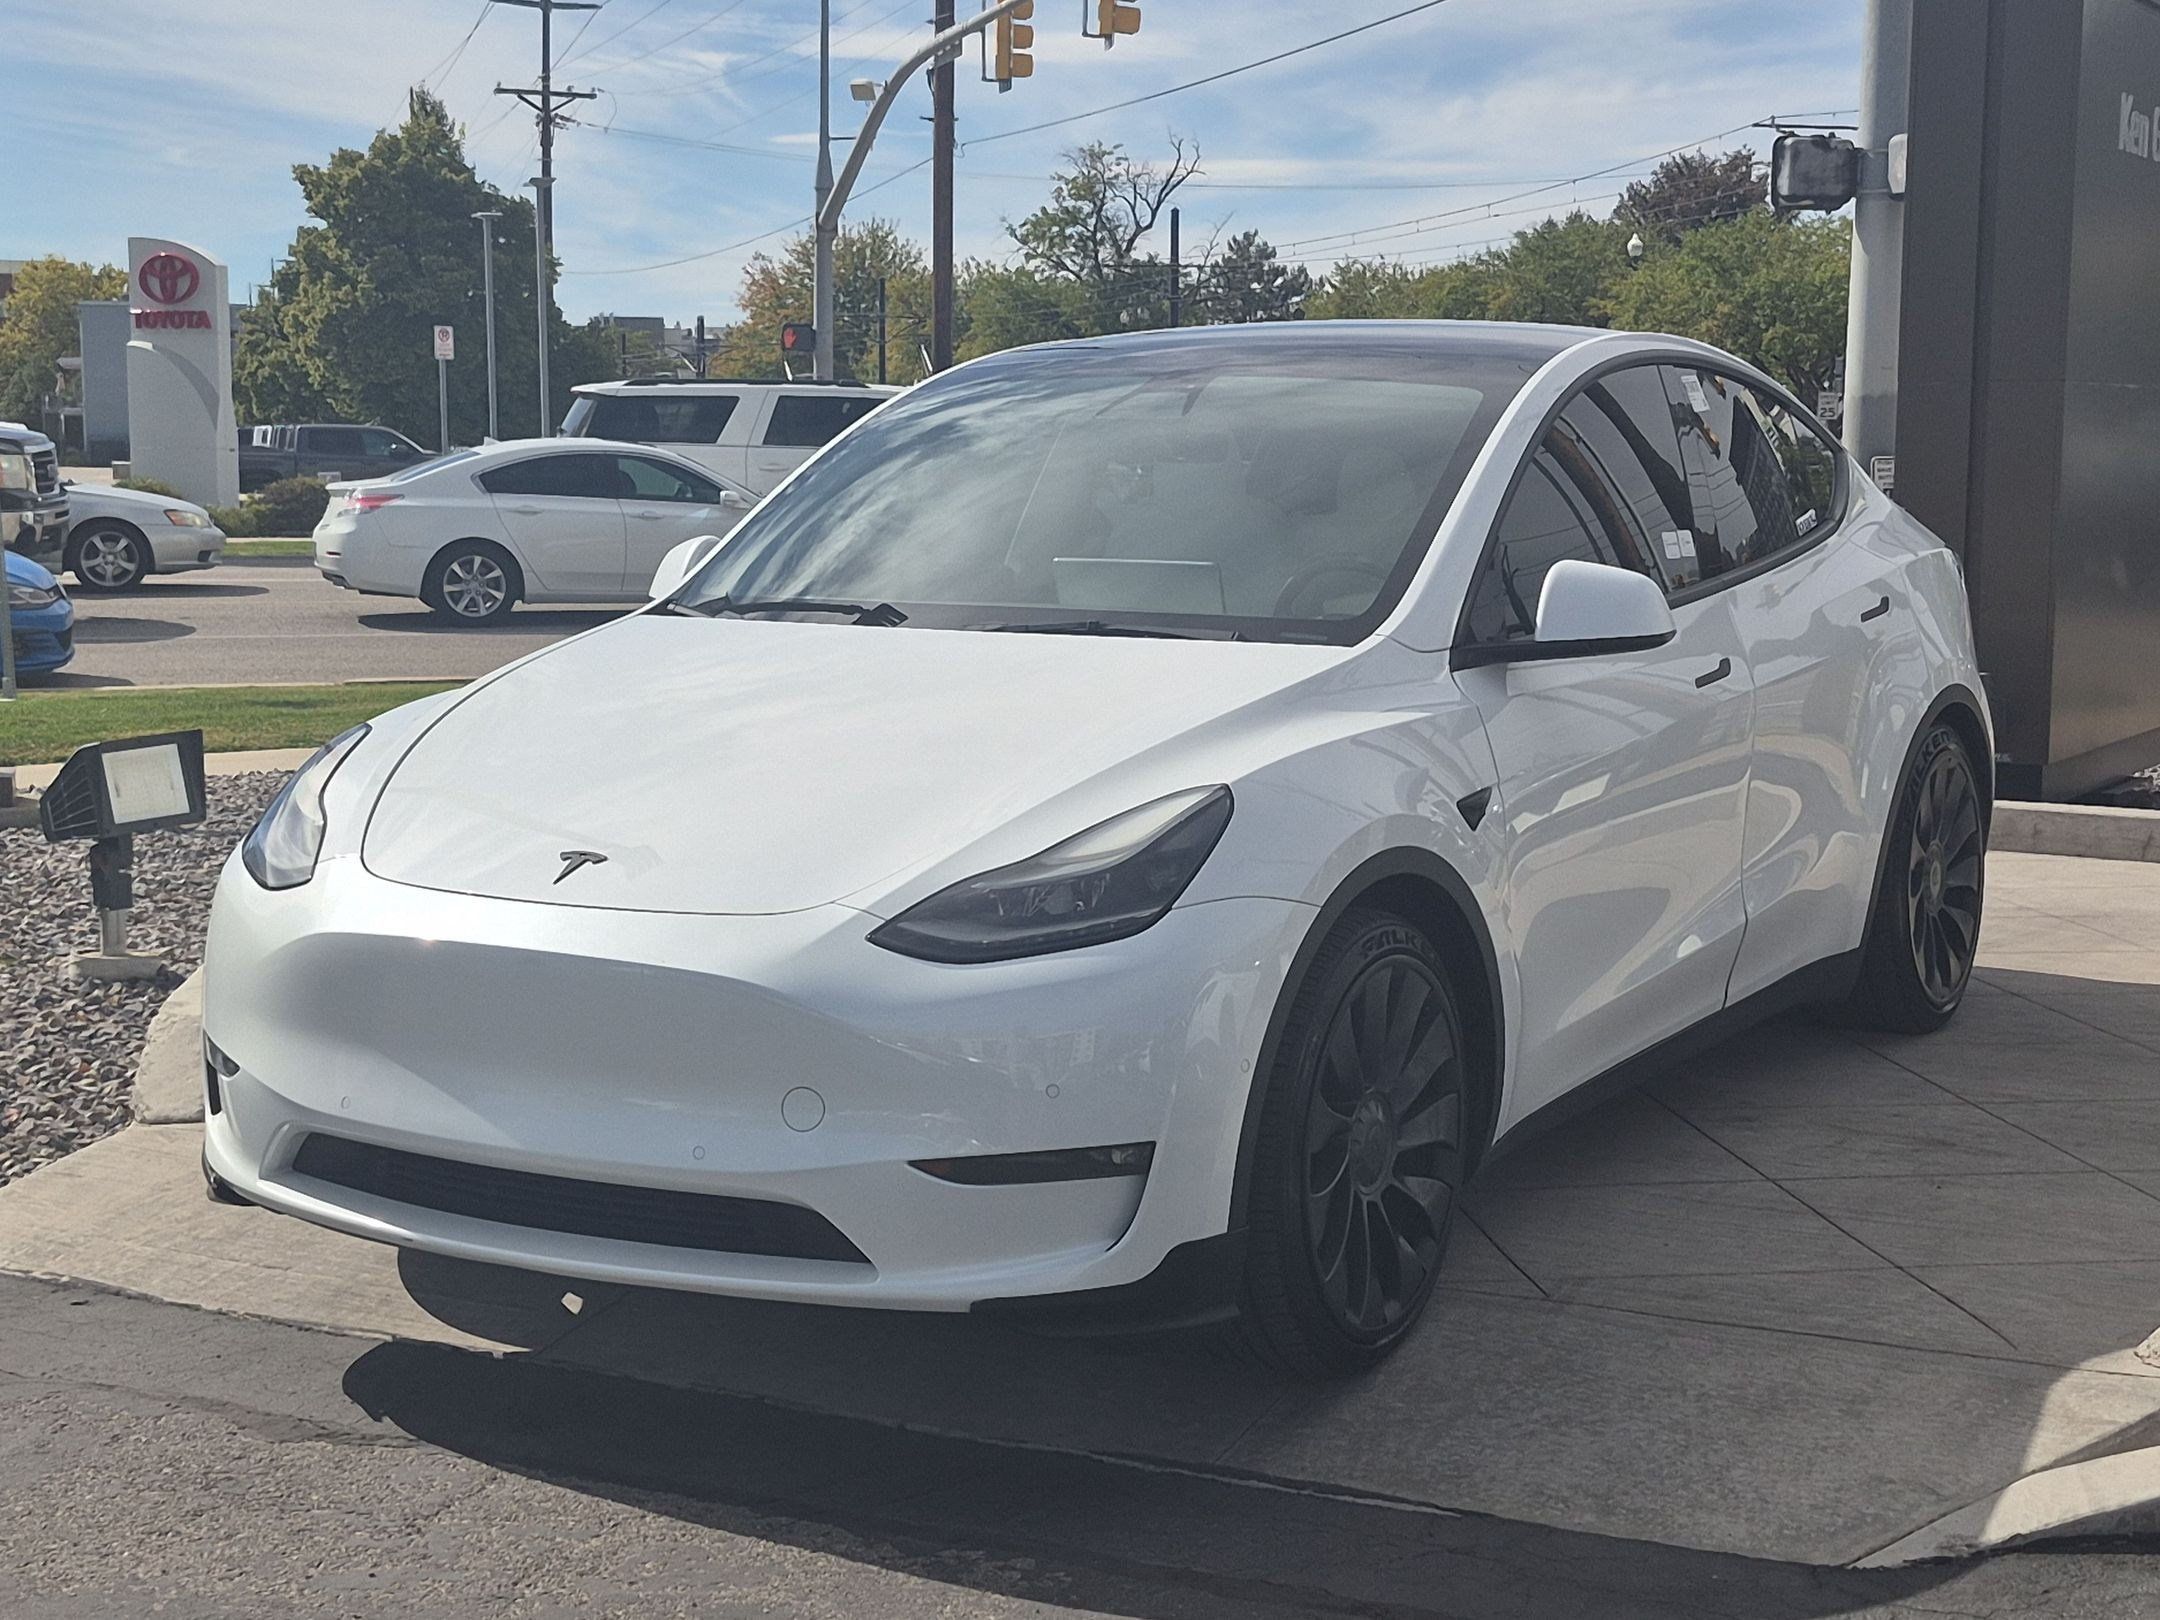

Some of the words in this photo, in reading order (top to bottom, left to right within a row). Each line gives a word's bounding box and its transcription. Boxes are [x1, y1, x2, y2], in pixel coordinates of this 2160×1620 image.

[2118, 91, 2150, 158] Ken
[131, 309, 213, 329] TOYOTA
[1820, 407, 1836, 418] 25
